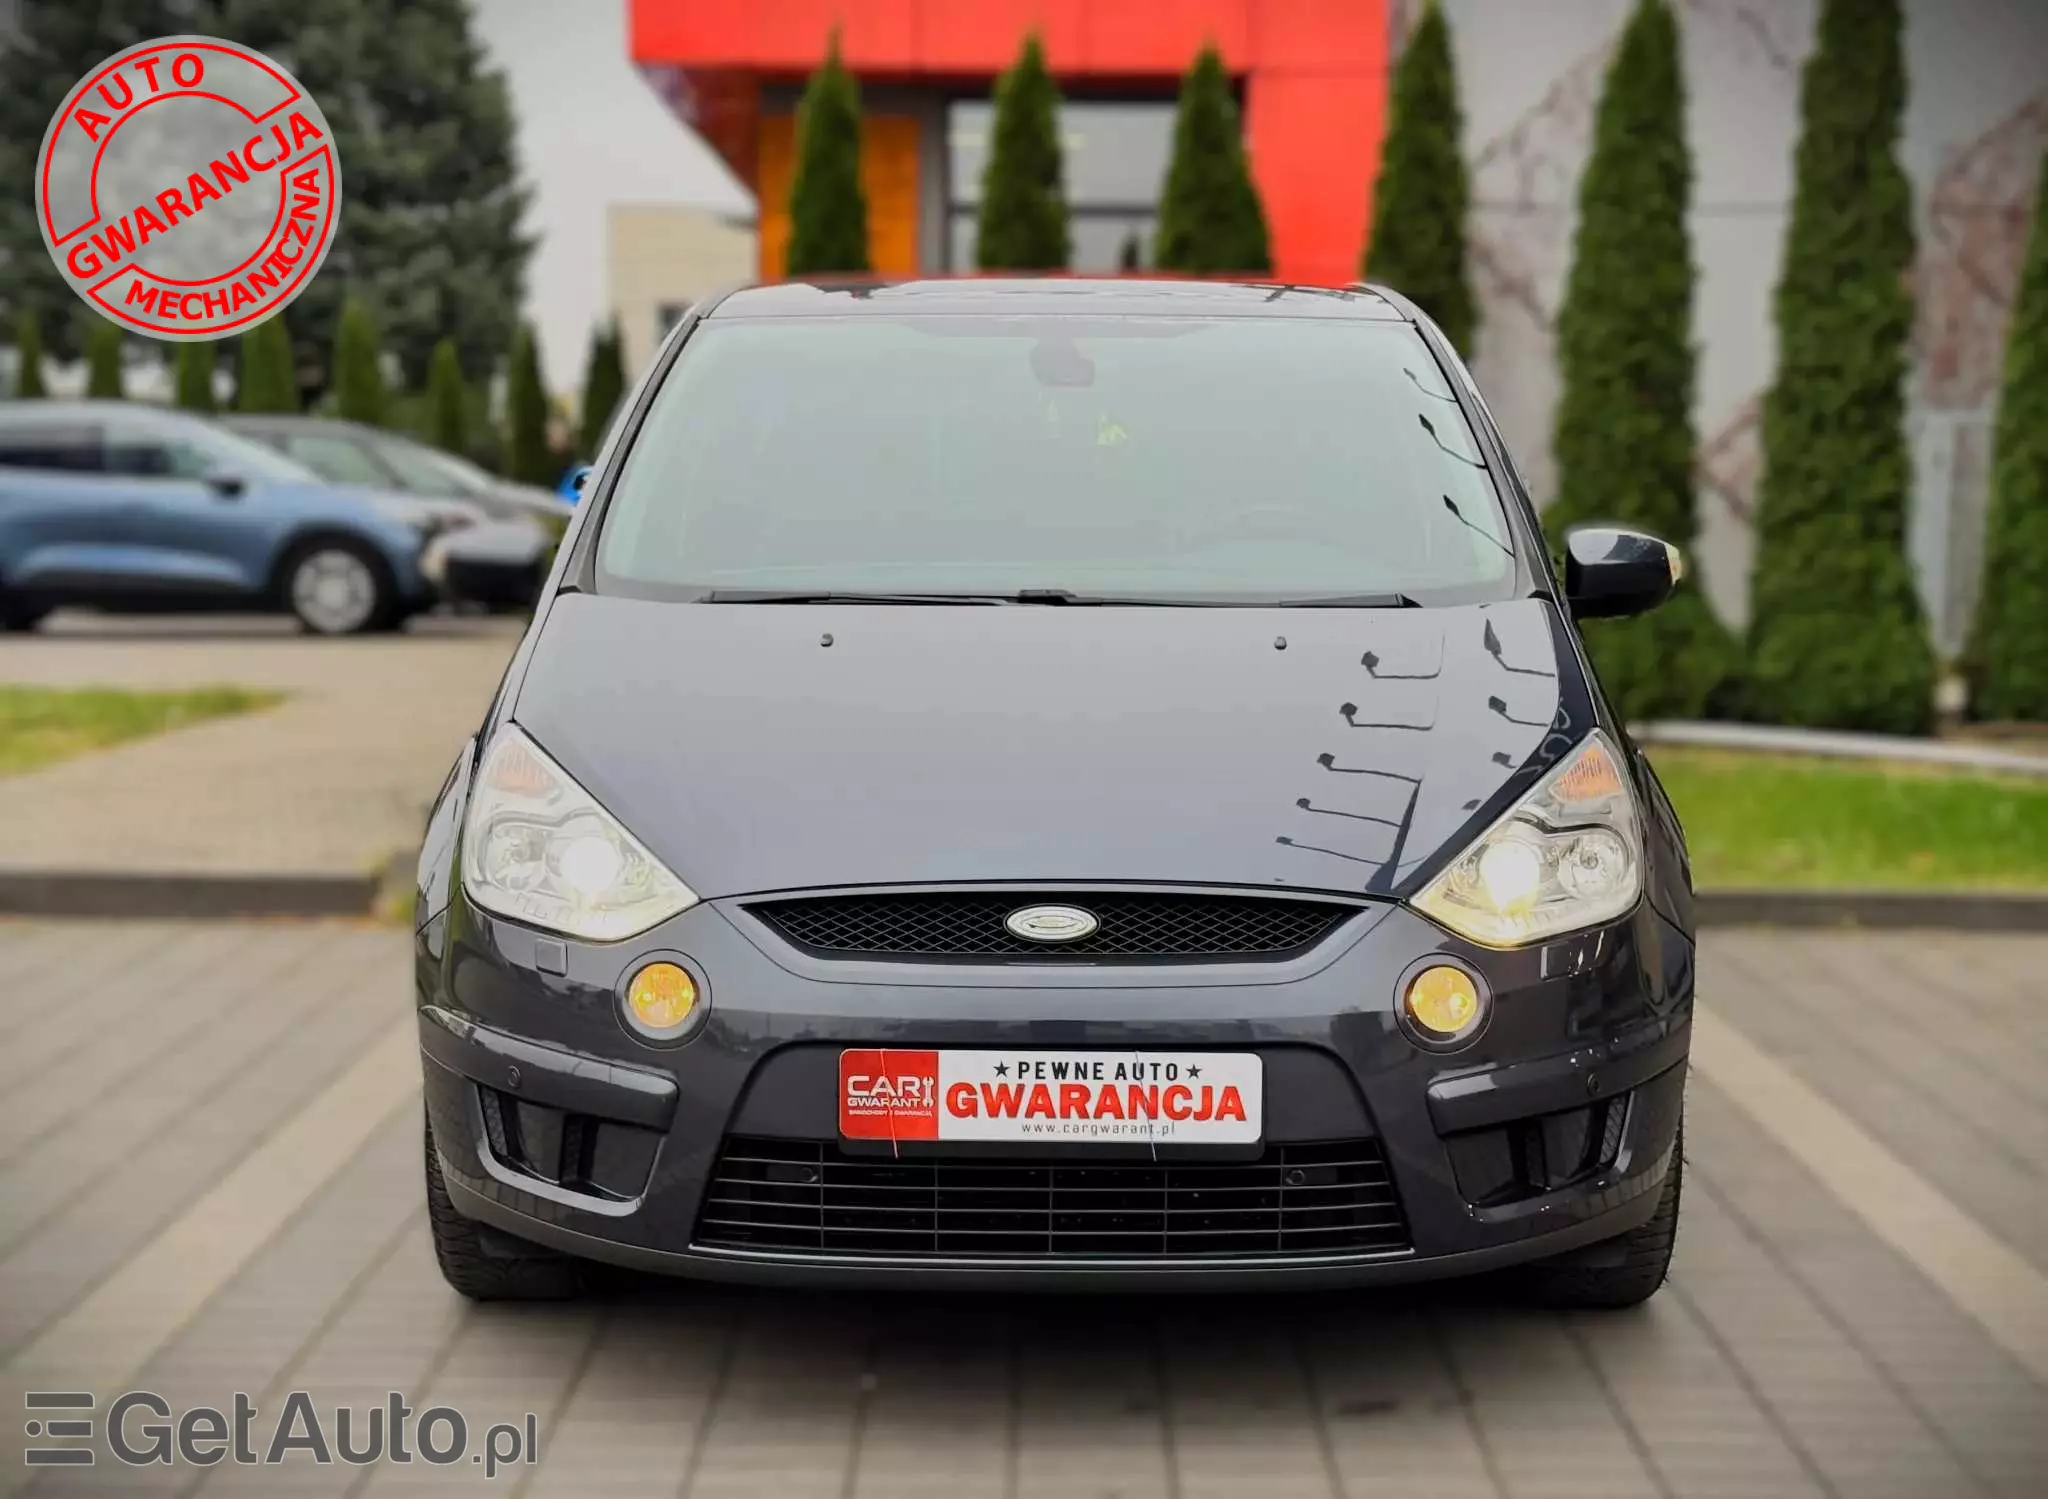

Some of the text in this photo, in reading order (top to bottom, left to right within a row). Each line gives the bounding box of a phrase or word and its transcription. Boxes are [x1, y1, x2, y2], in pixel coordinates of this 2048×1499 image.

[1018, 1061, 1179, 1081] PEWNE AUTO
[847, 1075, 921, 1097] CAR
[847, 1097, 921, 1108] GWARANT
[945, 1082, 1247, 1121] GWARANCJA
[1022, 1121, 1176, 1136] www.cargwarant.pl
